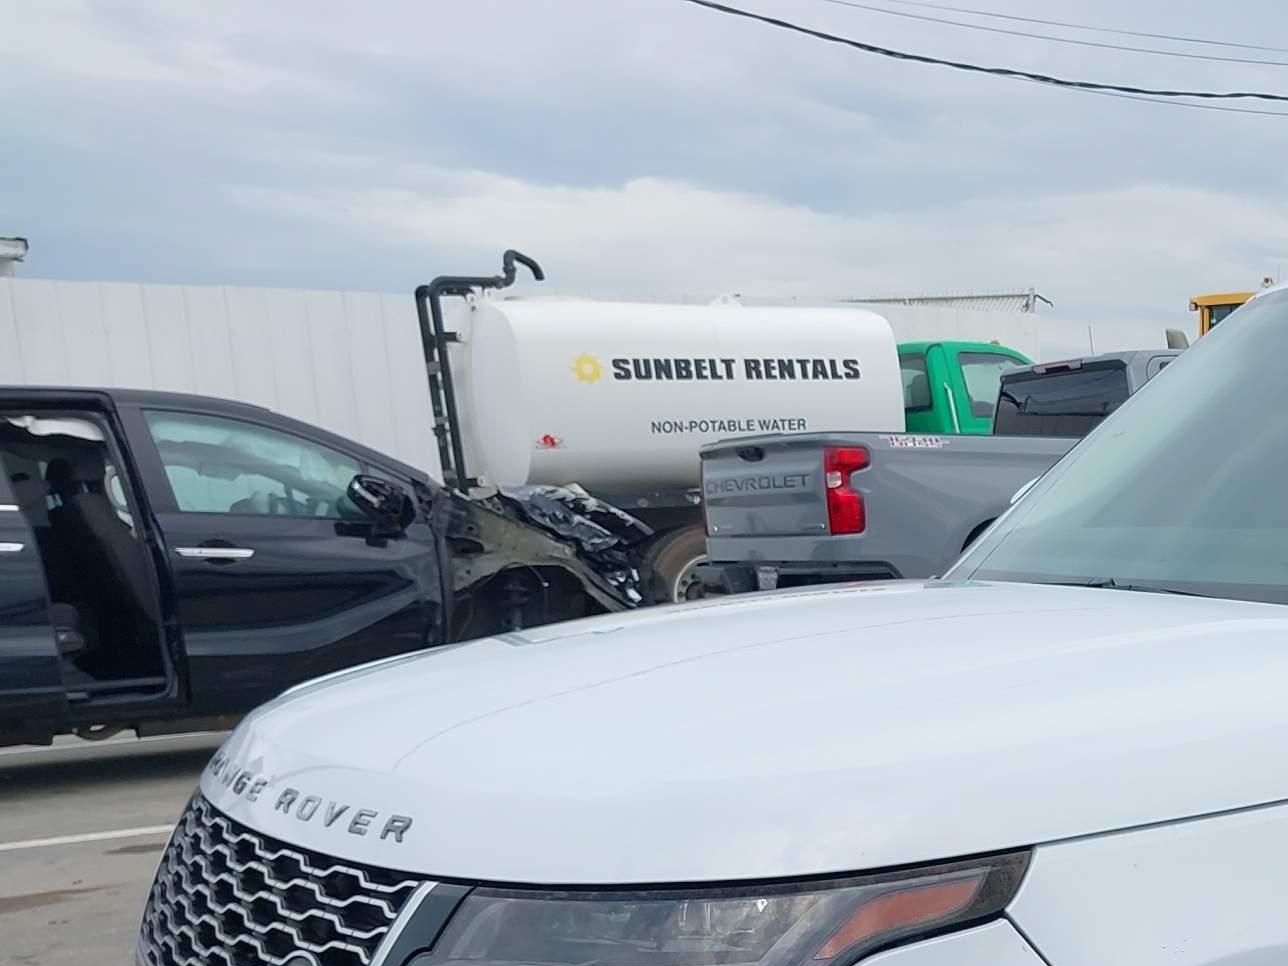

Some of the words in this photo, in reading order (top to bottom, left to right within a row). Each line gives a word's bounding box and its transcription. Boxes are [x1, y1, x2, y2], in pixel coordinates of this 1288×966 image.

[611, 357, 737, 381] SUNBELT
[743, 357, 861, 380] RENTALS
[650, 418, 756, 434] NON-POTABLE
[757, 417, 807, 432] WATER
[705, 473, 811, 495] CHEVROLET
[273, 787, 414, 844] ROVER
